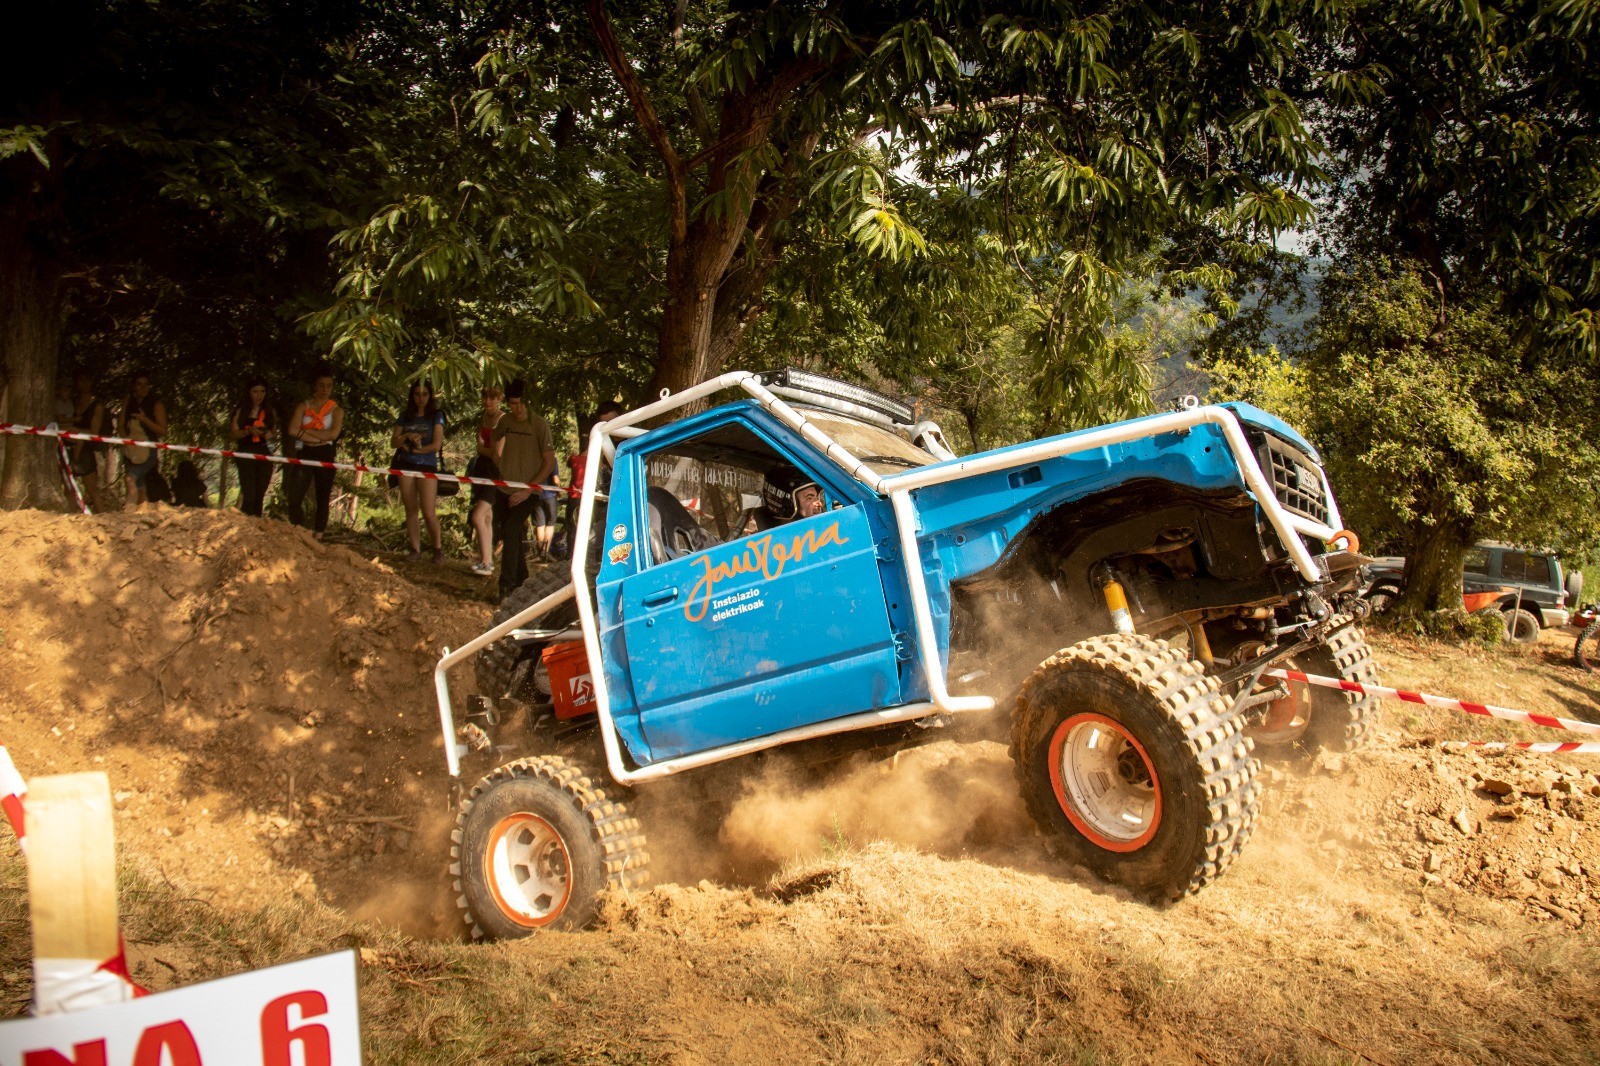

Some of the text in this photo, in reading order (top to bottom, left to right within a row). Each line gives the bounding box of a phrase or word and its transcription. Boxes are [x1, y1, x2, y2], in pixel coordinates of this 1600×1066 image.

[712, 588, 760, 609] Instalazio
[712, 599, 765, 622] elektrikoak
[260, 990, 332, 1066] 6
